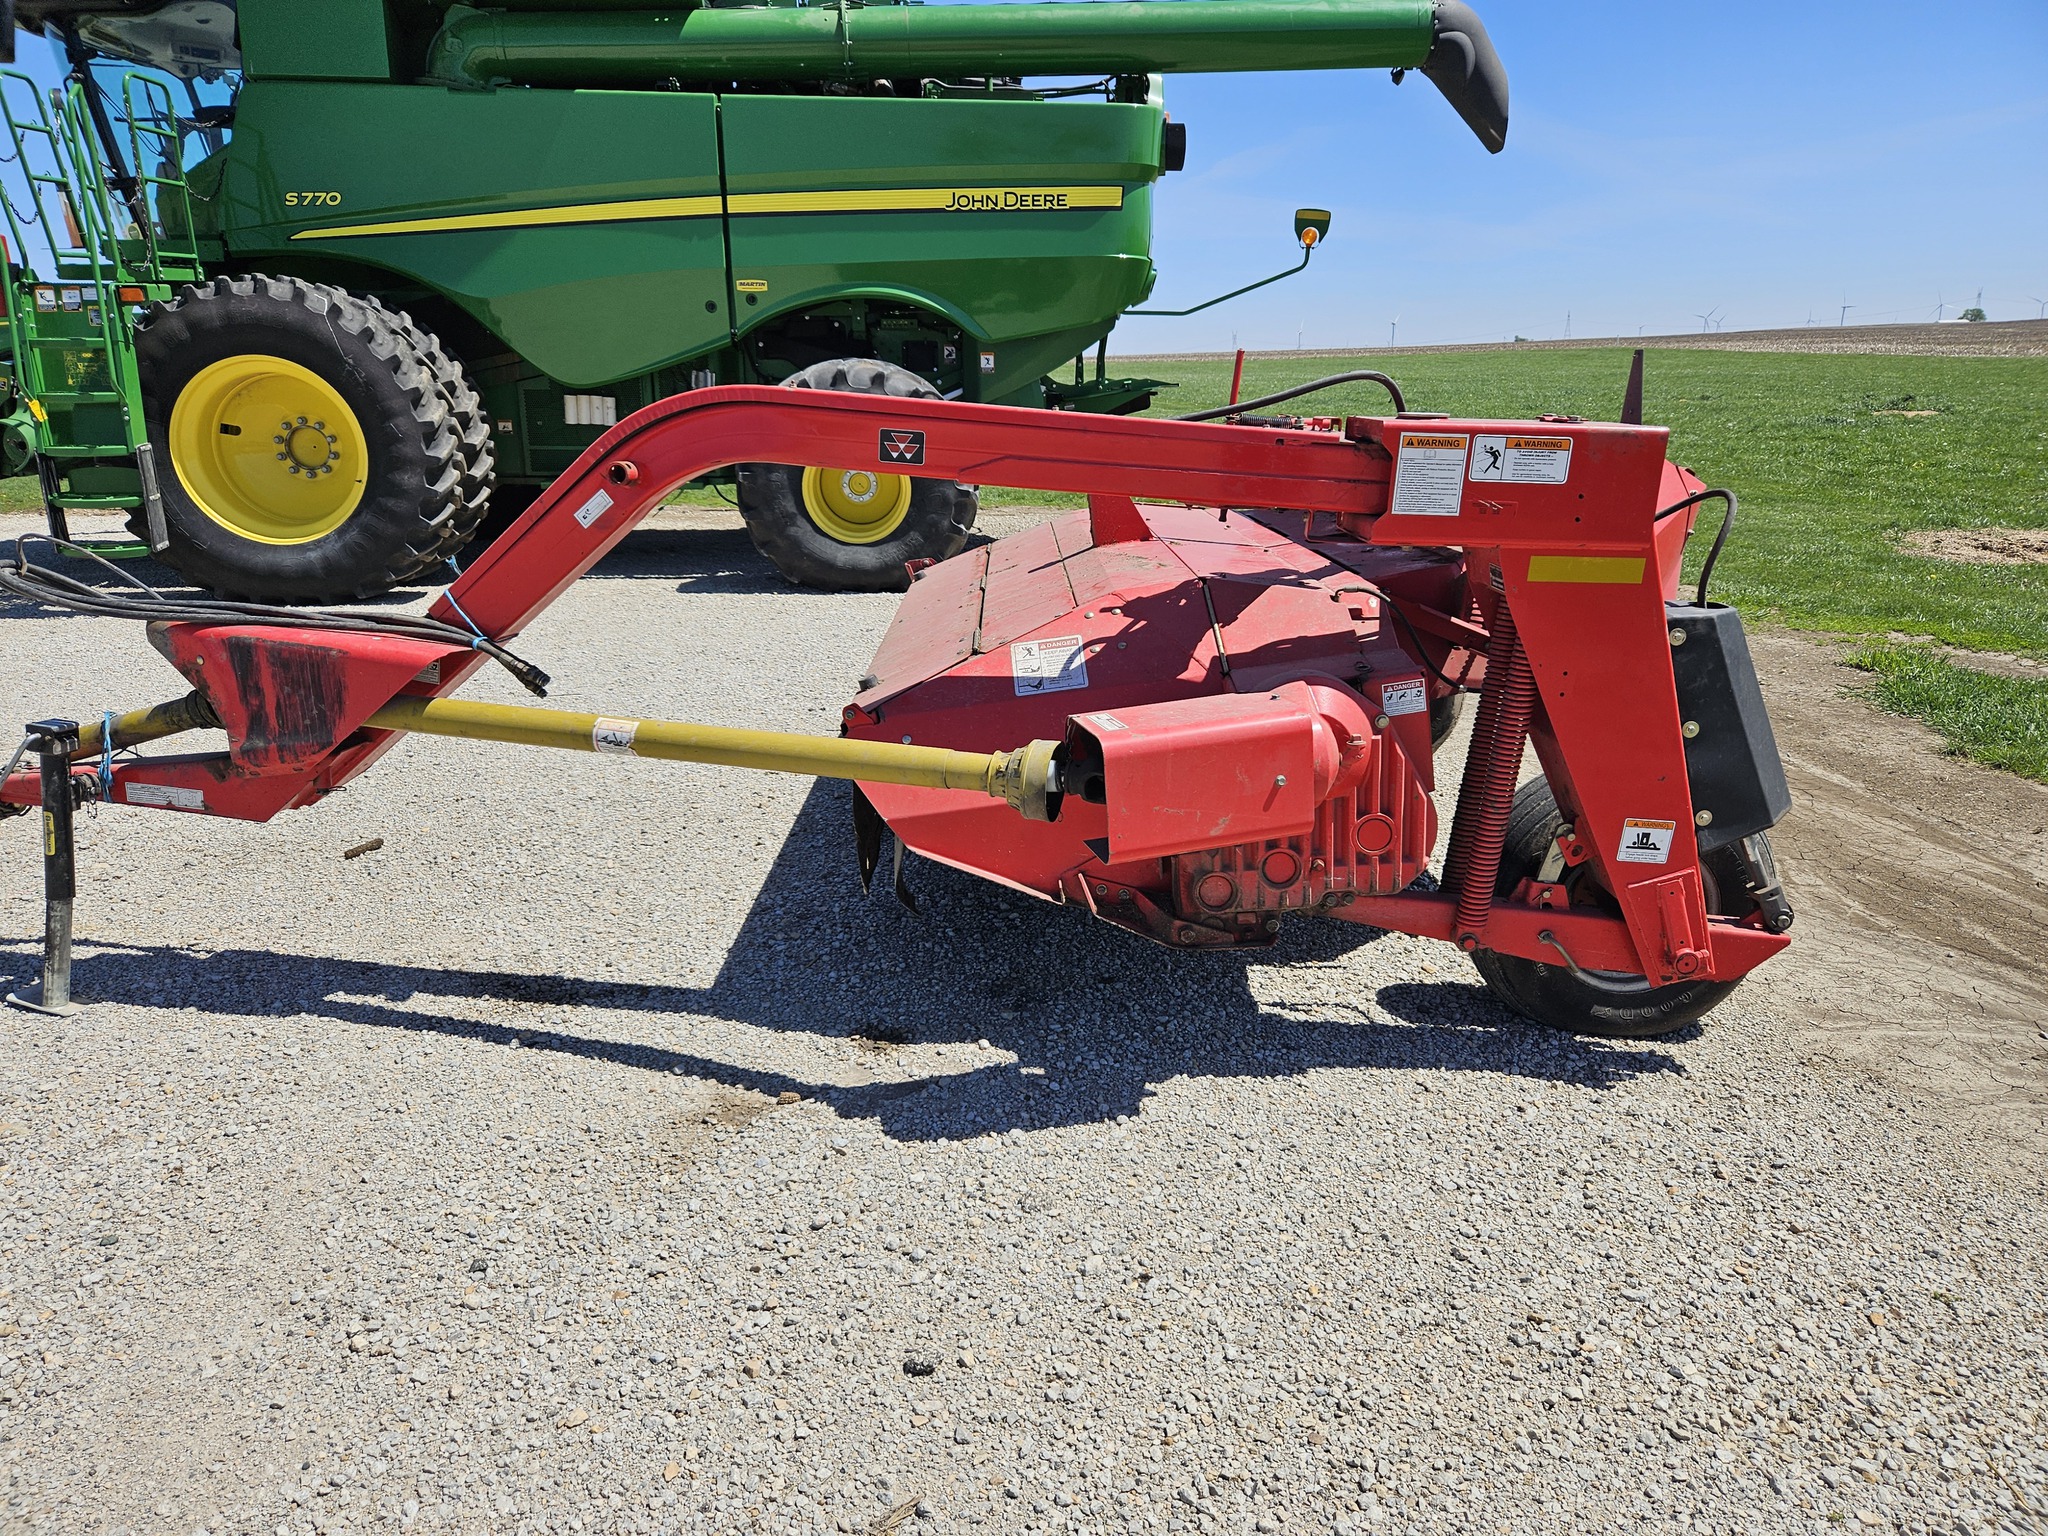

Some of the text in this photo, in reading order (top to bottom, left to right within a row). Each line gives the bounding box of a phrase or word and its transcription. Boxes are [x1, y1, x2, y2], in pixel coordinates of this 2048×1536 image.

[285, 191, 342, 206] S770
[945, 191, 1068, 209] JOHN DEERE
[1417, 438, 1460, 448] WARNING
[1524, 440, 1562, 449] WARNING
[1046, 640, 1077, 648] DANGER
[1393, 681, 1421, 691] DANGER
